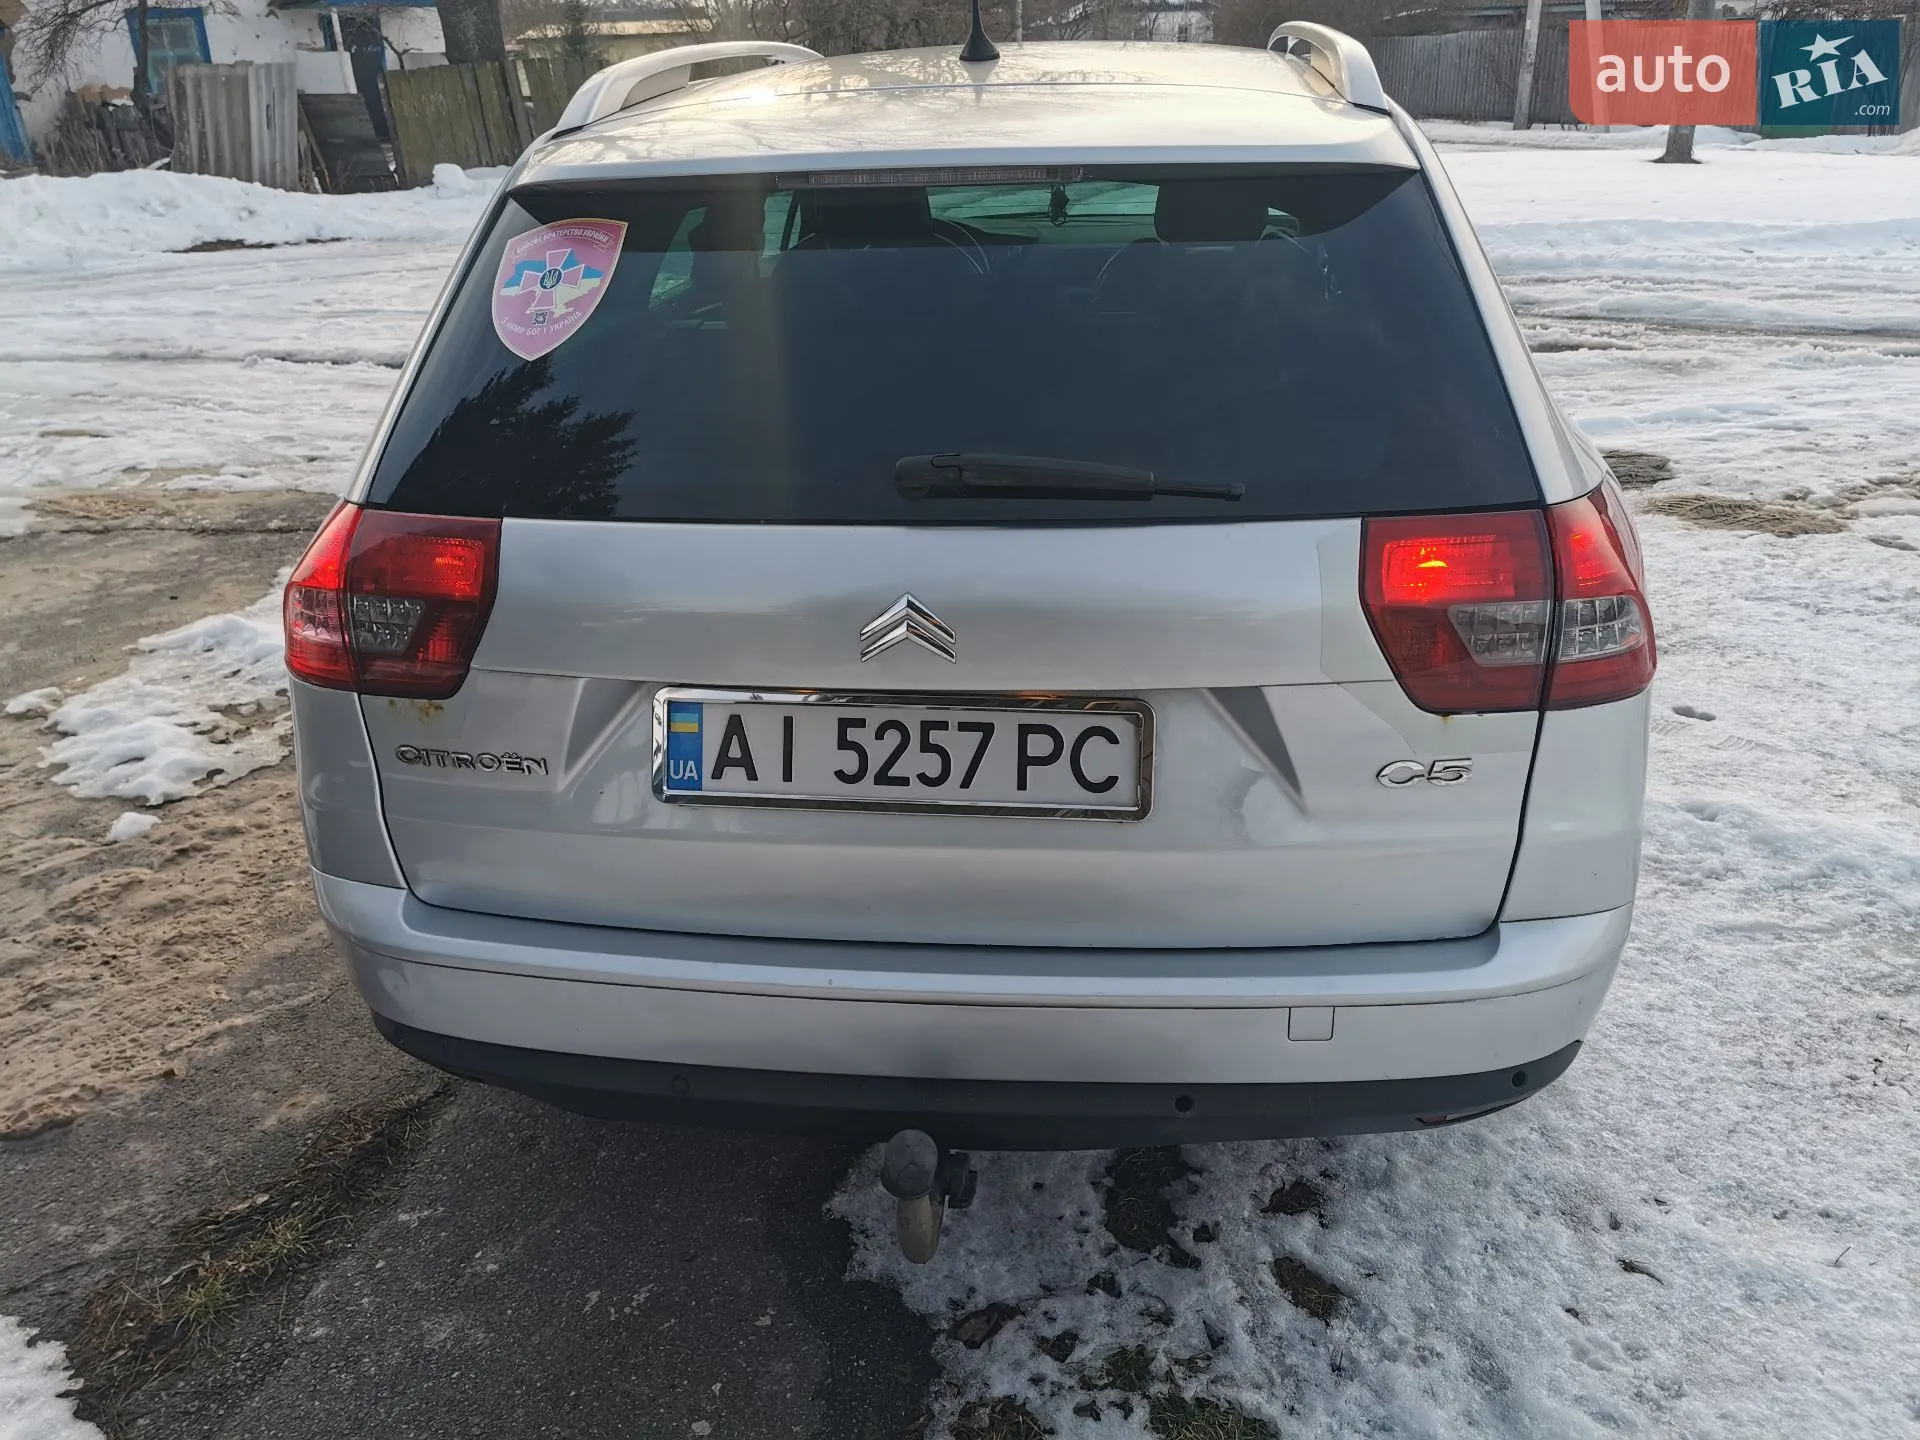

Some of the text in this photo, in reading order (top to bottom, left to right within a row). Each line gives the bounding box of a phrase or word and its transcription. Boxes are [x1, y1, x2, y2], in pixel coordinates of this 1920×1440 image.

[543, 228, 582, 242] БРАТЕРСТВО
[506, 321, 525, 335] НАМИ
[526, 327, 541, 336] БОГ
[549, 311, 583, 333] УКРАЇНА
[396, 744, 549, 776] CITROËN
[711, 713, 1120, 794] AI 5257 PC
[669, 758, 699, 781] UA
[1376, 757, 1473, 789] C5
